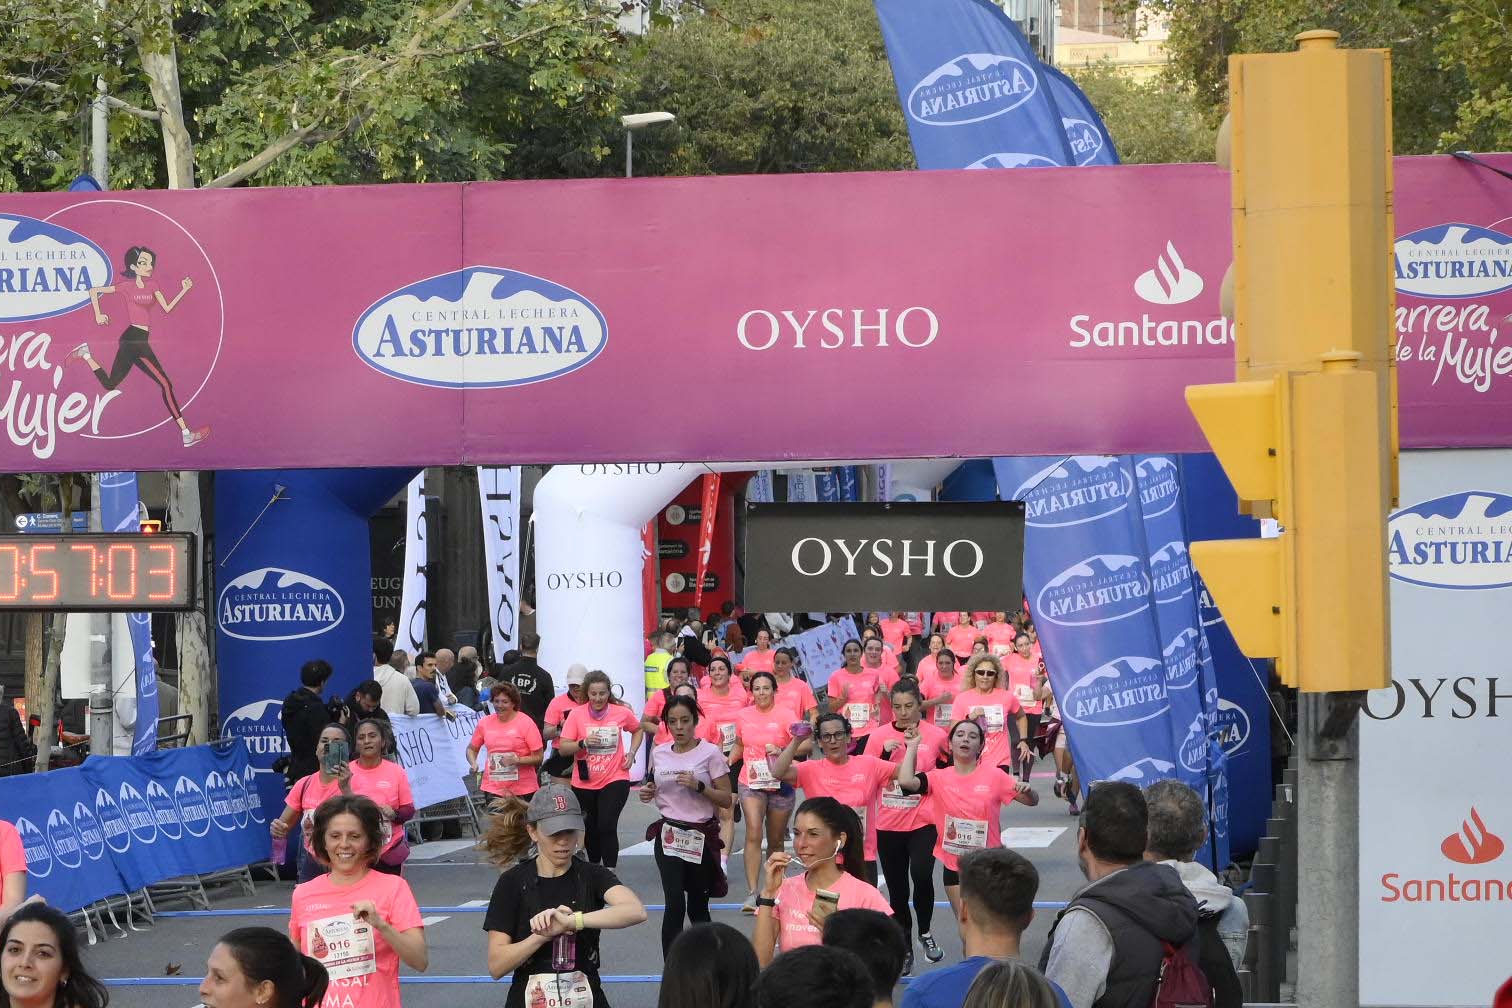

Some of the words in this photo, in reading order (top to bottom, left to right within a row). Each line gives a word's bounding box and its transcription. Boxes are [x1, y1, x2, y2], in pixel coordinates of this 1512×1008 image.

[15, 249, 89, 262] LECHERA
[411, 309, 488, 322] CENTRAL
[498, 306, 581, 320] LECHERA
[1395, 303, 1490, 333] arrera
[371, 312, 588, 359] ASTURIANA
[736, 306, 940, 351] OYSHO
[1069, 314, 1235, 349] Santand
[1418, 334, 1436, 362] la
[1416, 525, 1484, 537] CENTRAL
[791, 537, 985, 578] OYSHO
[546, 570, 623, 590] OYSHO
[234, 592, 278, 601] CENTRAL
[282, 592, 331, 601] LECHERA
[221, 597, 335, 625] ASTURIANA
[516, 678, 531, 688] BP
[236, 724, 278, 733] CENTRAL
[956, 833, 973, 841] 016
[329, 939, 351, 951] 016
[548, 997, 573, 1007] 016
